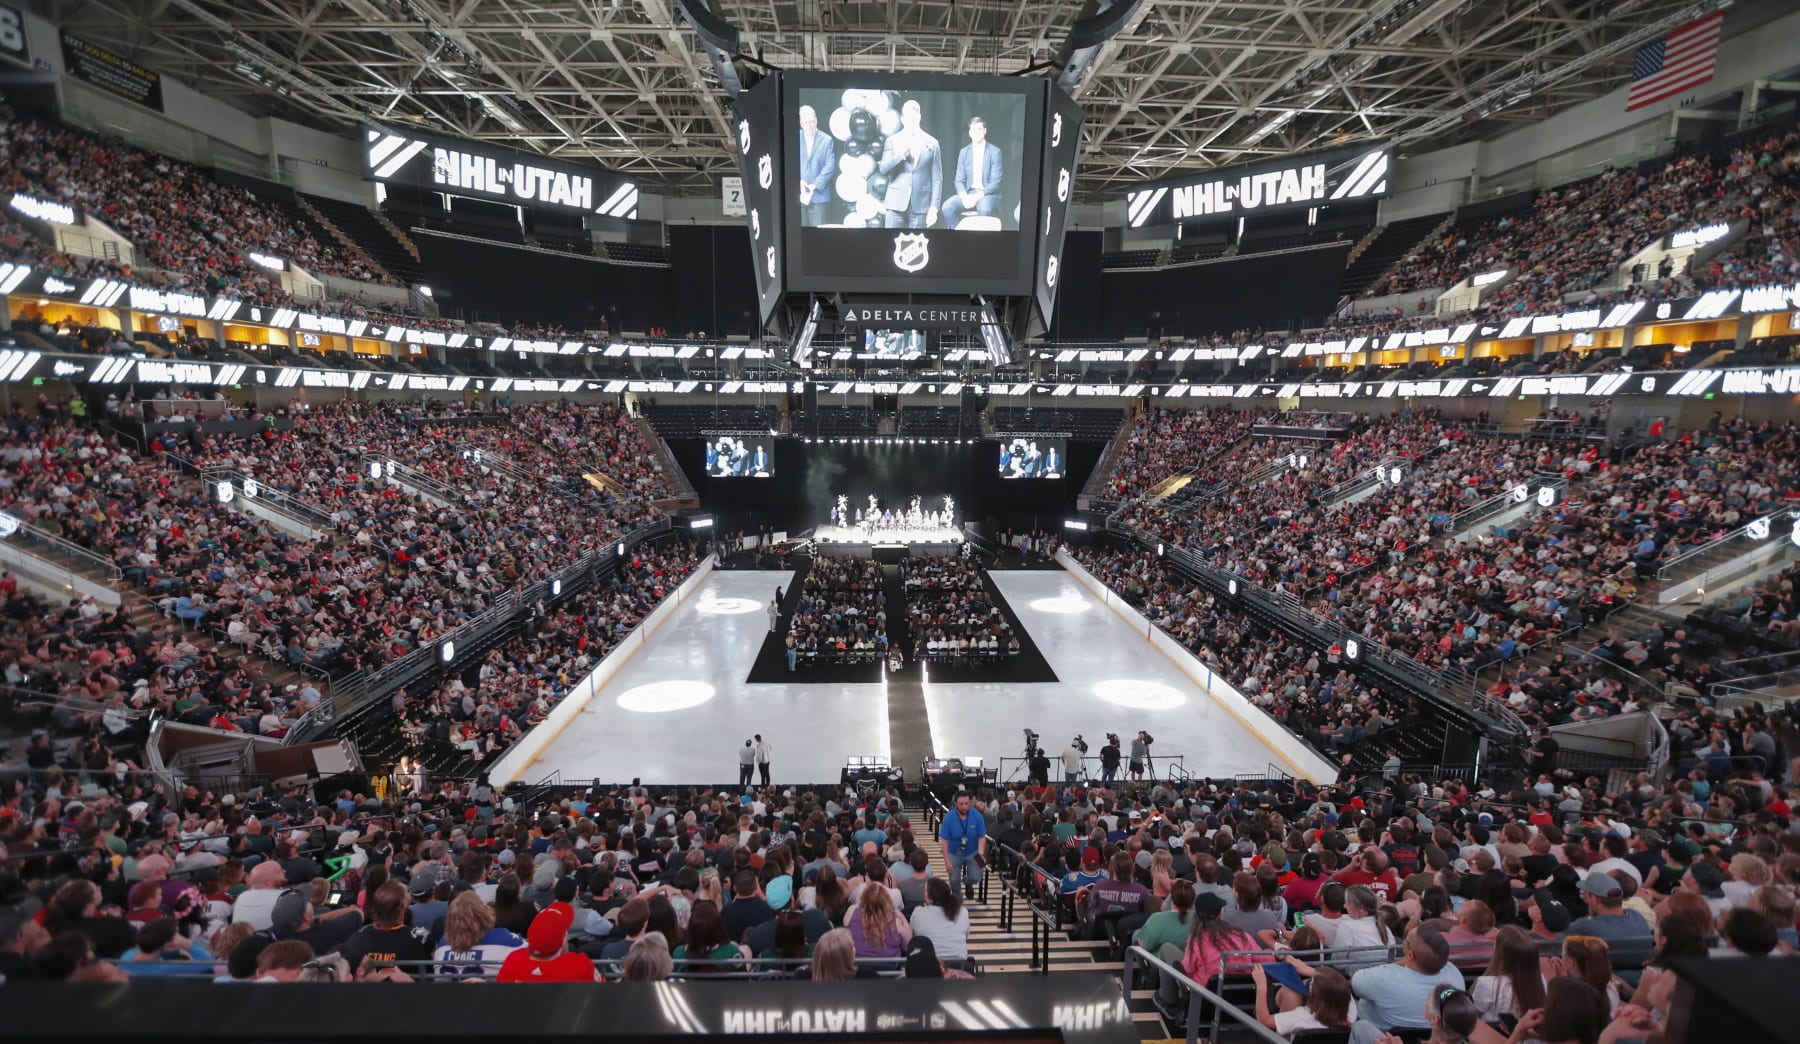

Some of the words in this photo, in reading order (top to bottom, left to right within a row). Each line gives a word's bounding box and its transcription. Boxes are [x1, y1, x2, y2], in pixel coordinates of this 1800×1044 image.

[435, 148, 505, 195] NHL
[498, 168, 513, 183] IN
[514, 164, 592, 209] UTAH
[1173, 181, 1232, 218] NHL
[1226, 185, 1240, 199] IN
[1240, 164, 1326, 209] UTAH
[731, 191, 740, 203] 7
[862, 310, 913, 321] DELTA
[919, 310, 977, 322] CENTER
